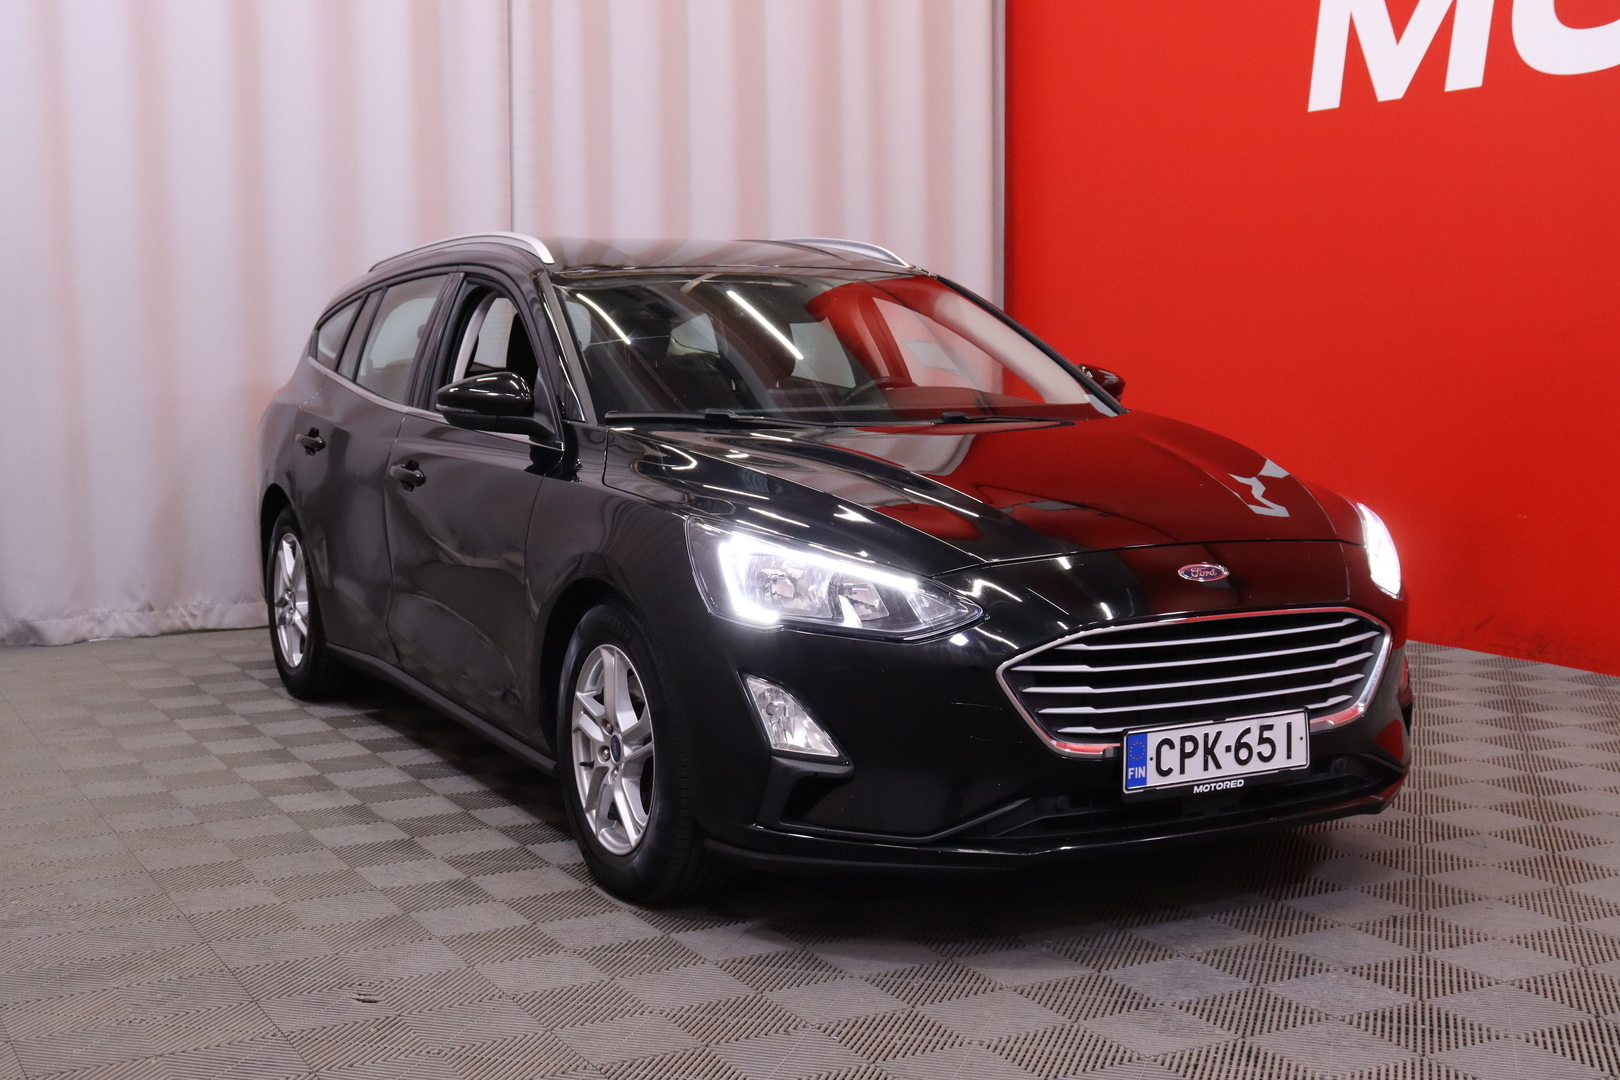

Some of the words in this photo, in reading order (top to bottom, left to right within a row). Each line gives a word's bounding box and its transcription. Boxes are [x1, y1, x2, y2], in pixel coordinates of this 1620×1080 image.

[1155, 721, 1292, 777] CPK-651
[1128, 766, 1146, 780] FIN
[1193, 779, 1245, 794] MOTORED
